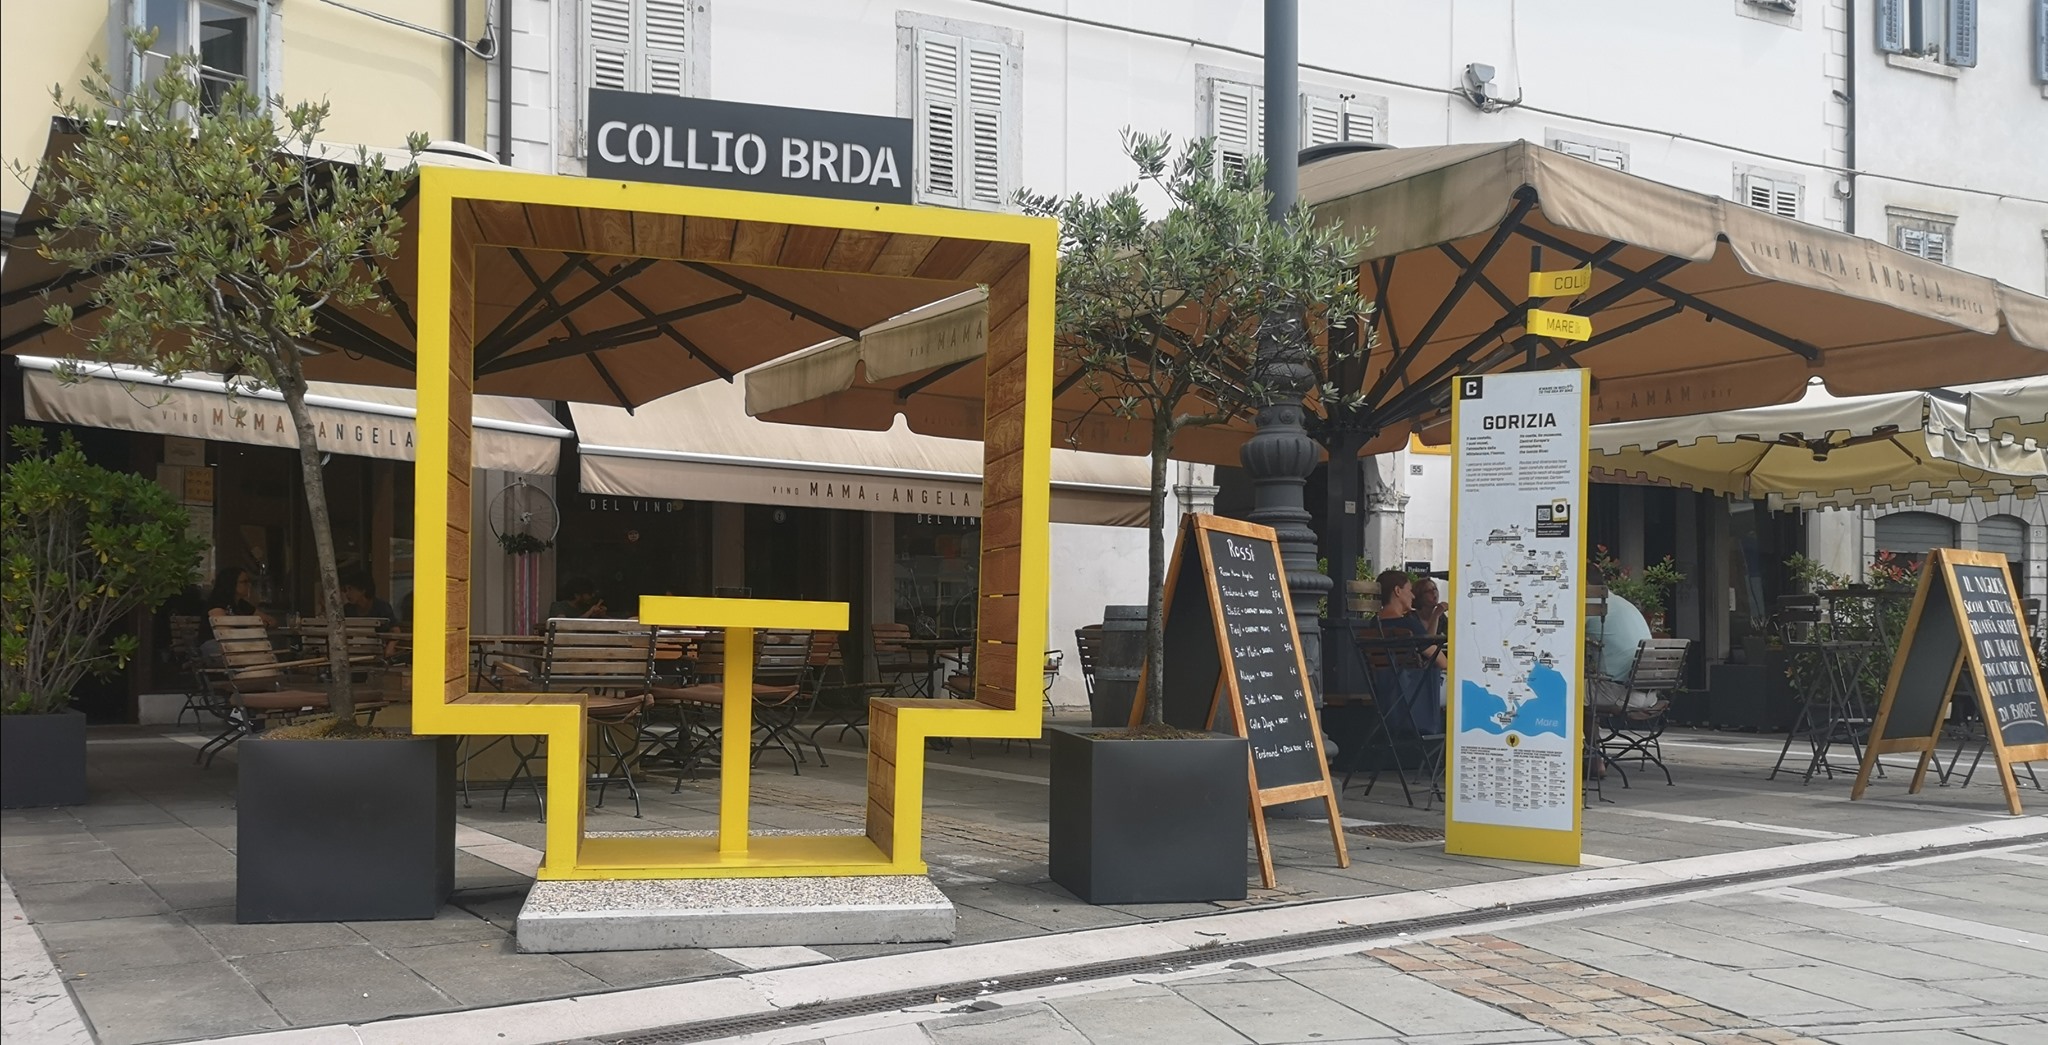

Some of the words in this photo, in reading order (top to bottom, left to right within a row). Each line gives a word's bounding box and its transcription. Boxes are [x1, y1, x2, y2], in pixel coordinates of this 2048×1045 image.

[596, 120, 767, 176] COLLIO
[781, 136, 902, 189] BRDA
[1750, 241, 1781, 260] VINO
[1788, 240, 1847, 276] MAMA
[1855, 267, 1861, 280] E
[1869, 261, 1943, 303] ANGELA
[1546, 318, 1574, 334] MARE
[937, 320, 982, 351] MAMA
[1466, 381, 1477, 396] C
[162, 410, 197, 424] VINO
[212, 407, 284, 434] MAMA
[318, 420, 414, 449] ANGELA
[1483, 413, 1556, 430] GORIZIA
[1412, 465, 1422, 473] 55
[772, 485, 799, 496] VINO
[809, 482, 866, 500] MAMA
[875, 493, 880, 501] E
[892, 488, 970, 507] ANGELA
[590, 498, 620, 511] DEL
[633, 500, 672, 513] VINO
[917, 513, 943, 525] DEL
[952, 515, 976, 526] VIN
[1226, 538, 1255, 562] Rossi
[1962, 576, 1975, 593] IL
[1963, 599, 1987, 614] SOCIAL
[1981, 639, 1996, 659] UN
[2021, 661, 2032, 676] DA
[2009, 678, 2016, 694] E
[1998, 706, 2012, 722] DI
[2012, 702, 2038, 721] BIRRE
[1536, 718, 1559, 727] Mare
